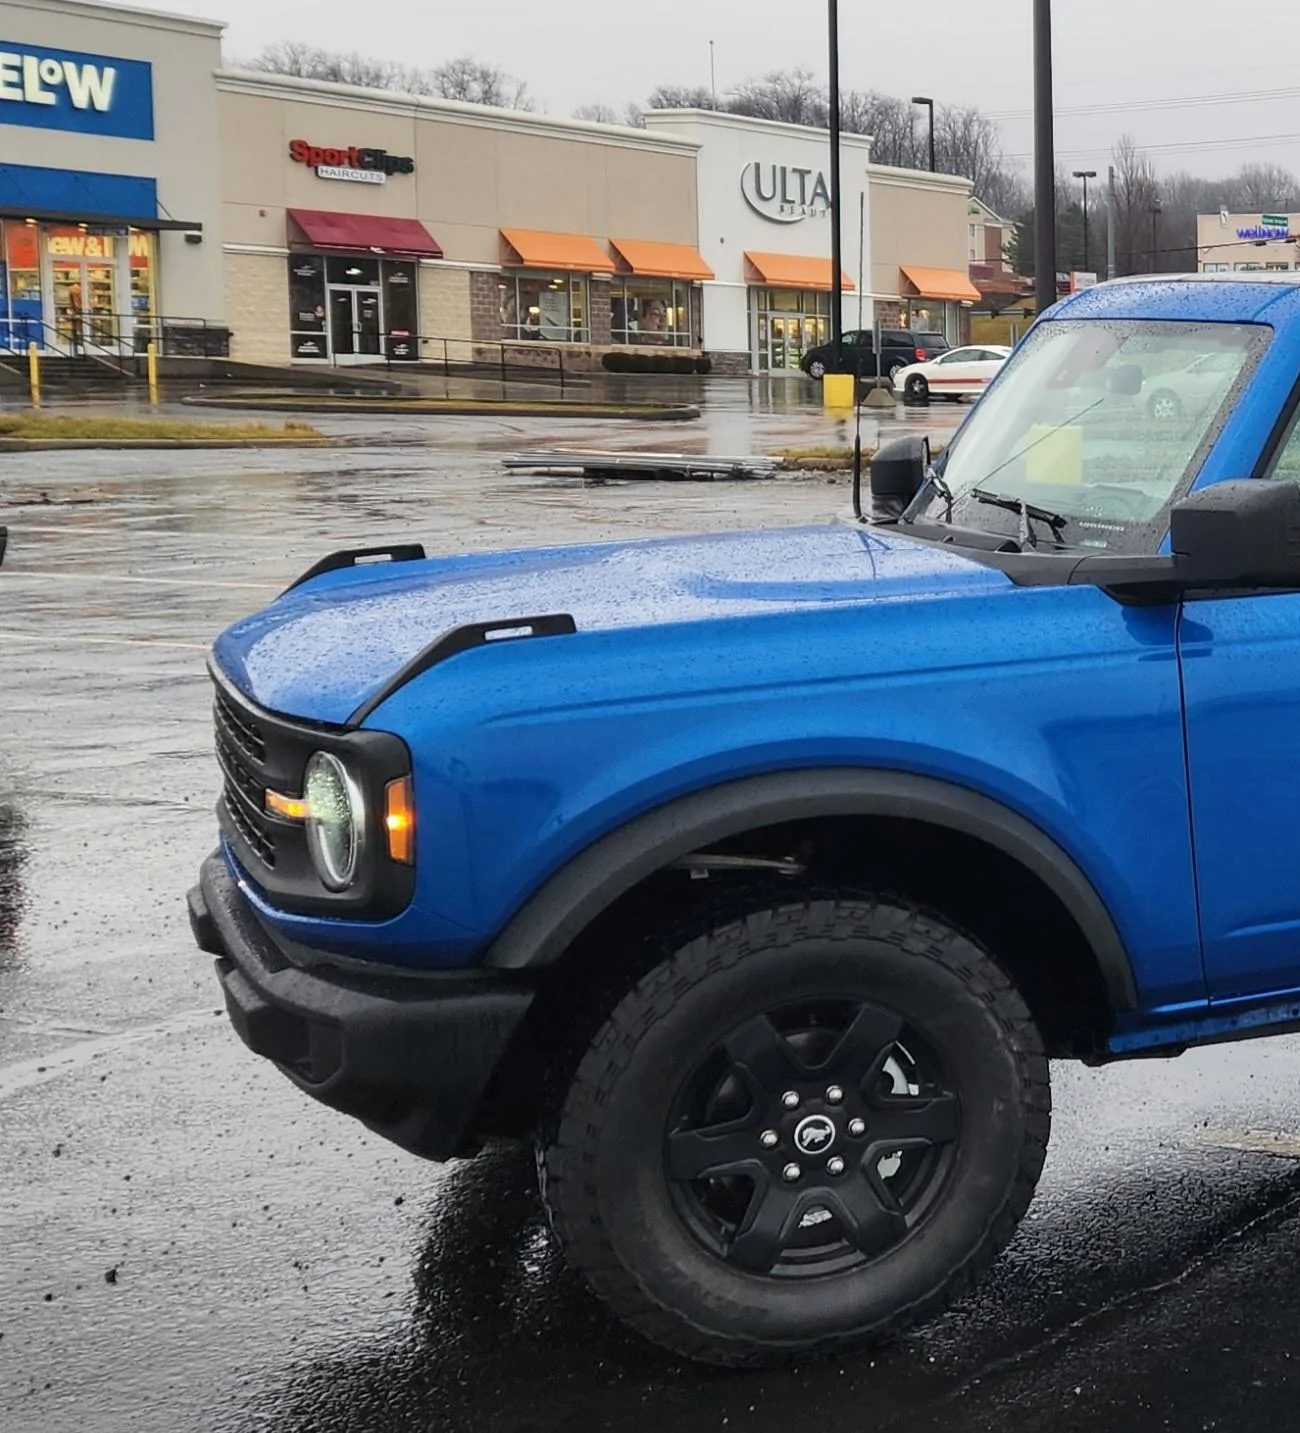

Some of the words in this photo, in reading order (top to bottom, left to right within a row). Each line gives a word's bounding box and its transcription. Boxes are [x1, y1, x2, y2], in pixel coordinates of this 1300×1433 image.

[320, 167, 384, 182] HAIRCUTS
[754, 161, 832, 208] ULTA
[779, 204, 827, 218] BEAUT
